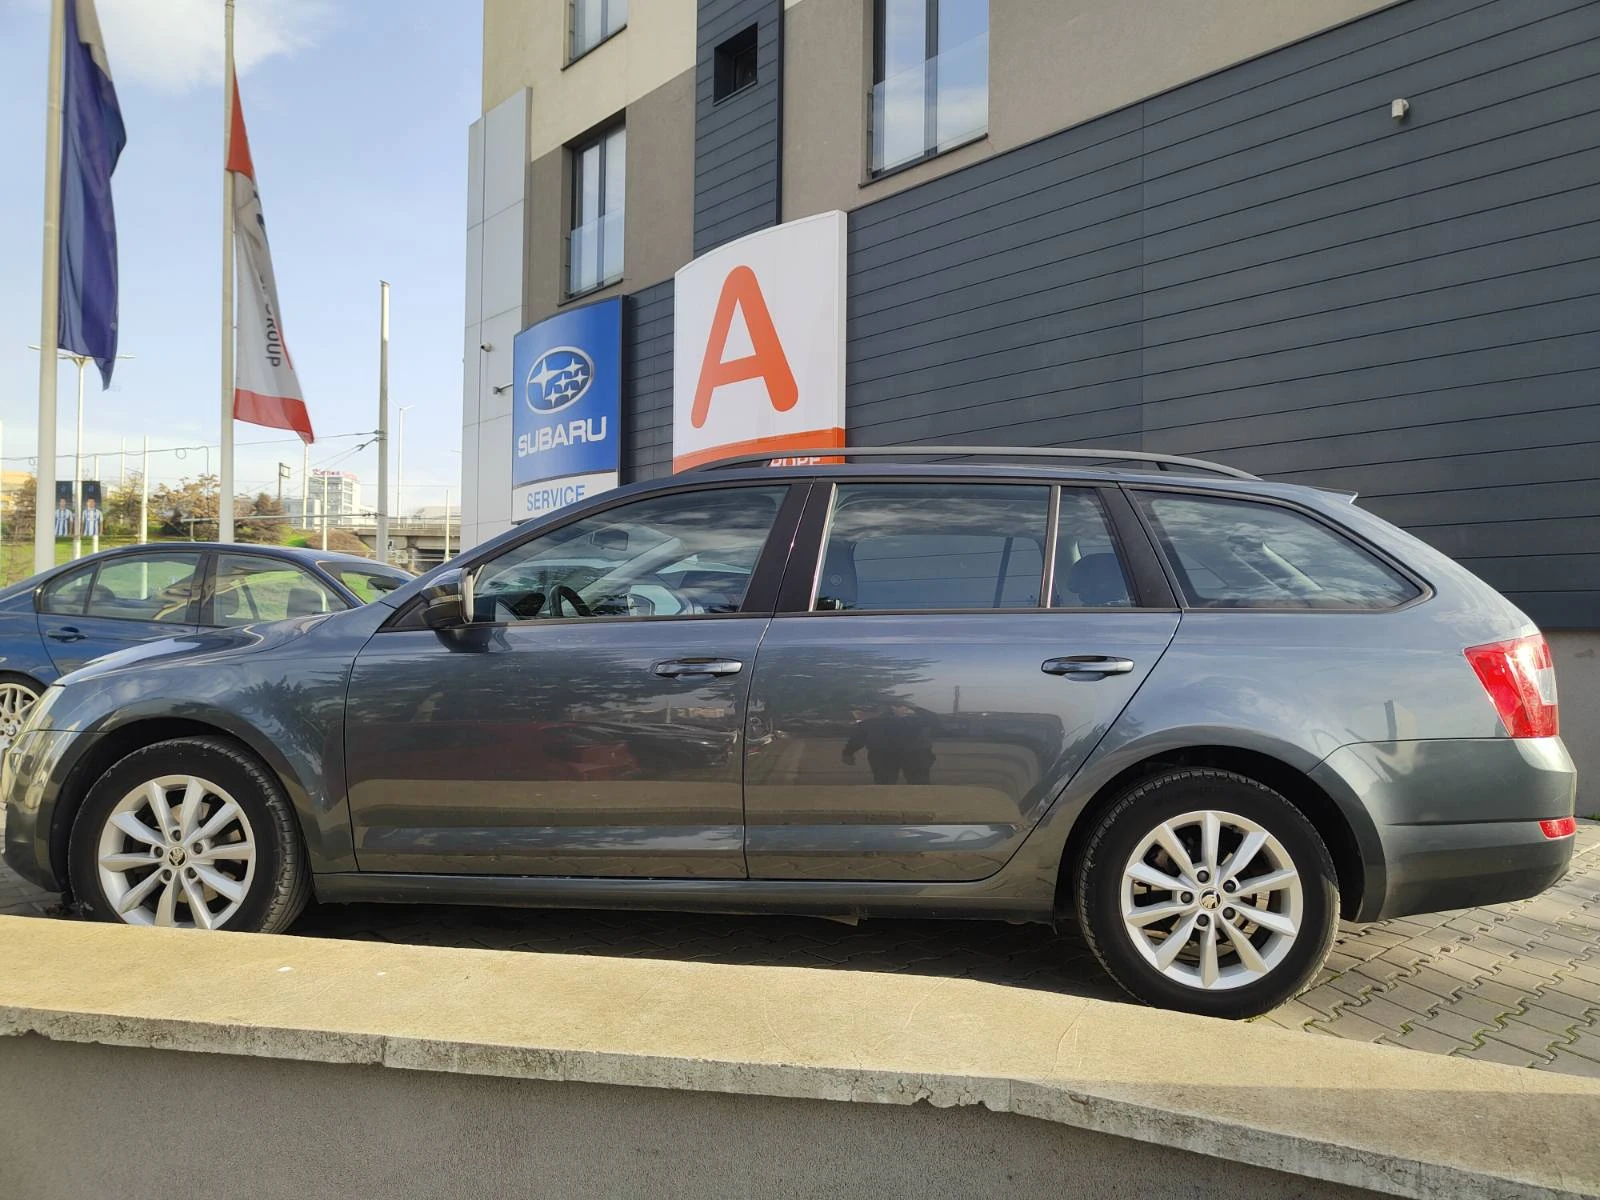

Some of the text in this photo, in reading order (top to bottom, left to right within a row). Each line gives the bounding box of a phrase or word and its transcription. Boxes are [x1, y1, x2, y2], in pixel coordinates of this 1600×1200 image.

[691, 265, 799, 429] A
[517, 416, 607, 458] SUBARU
[527, 484, 586, 512] SERVICE
